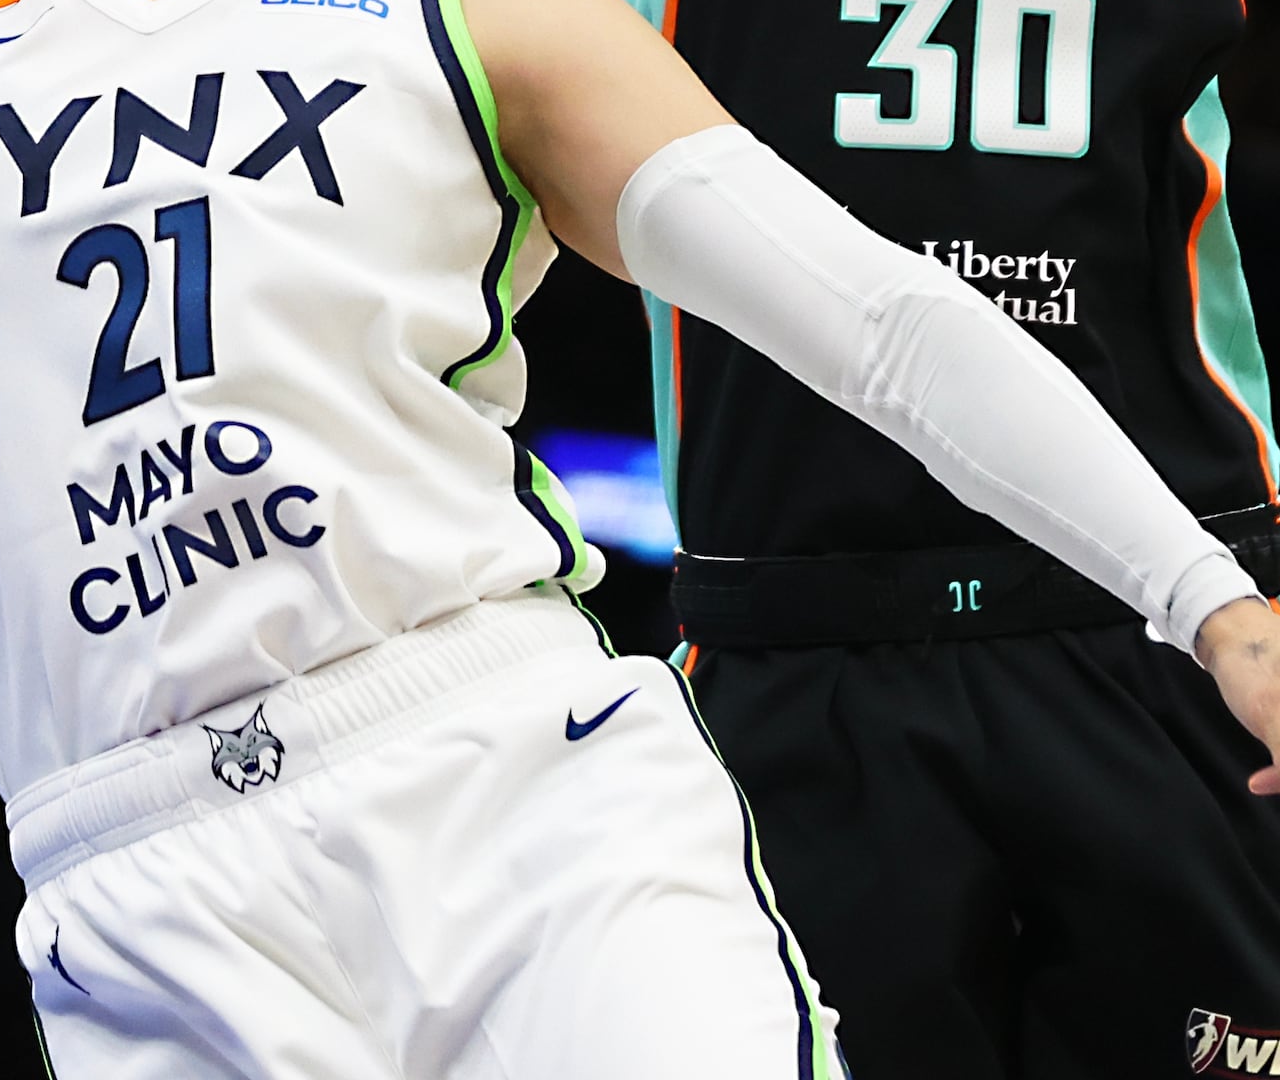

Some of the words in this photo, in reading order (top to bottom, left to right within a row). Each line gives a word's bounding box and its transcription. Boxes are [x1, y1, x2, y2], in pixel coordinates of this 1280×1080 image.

[56, 195, 215, 427] 21
[993, 288, 1078, 325] tual
[66, 420, 273, 546] MAYO
[69, 485, 327, 635] CLINIC
